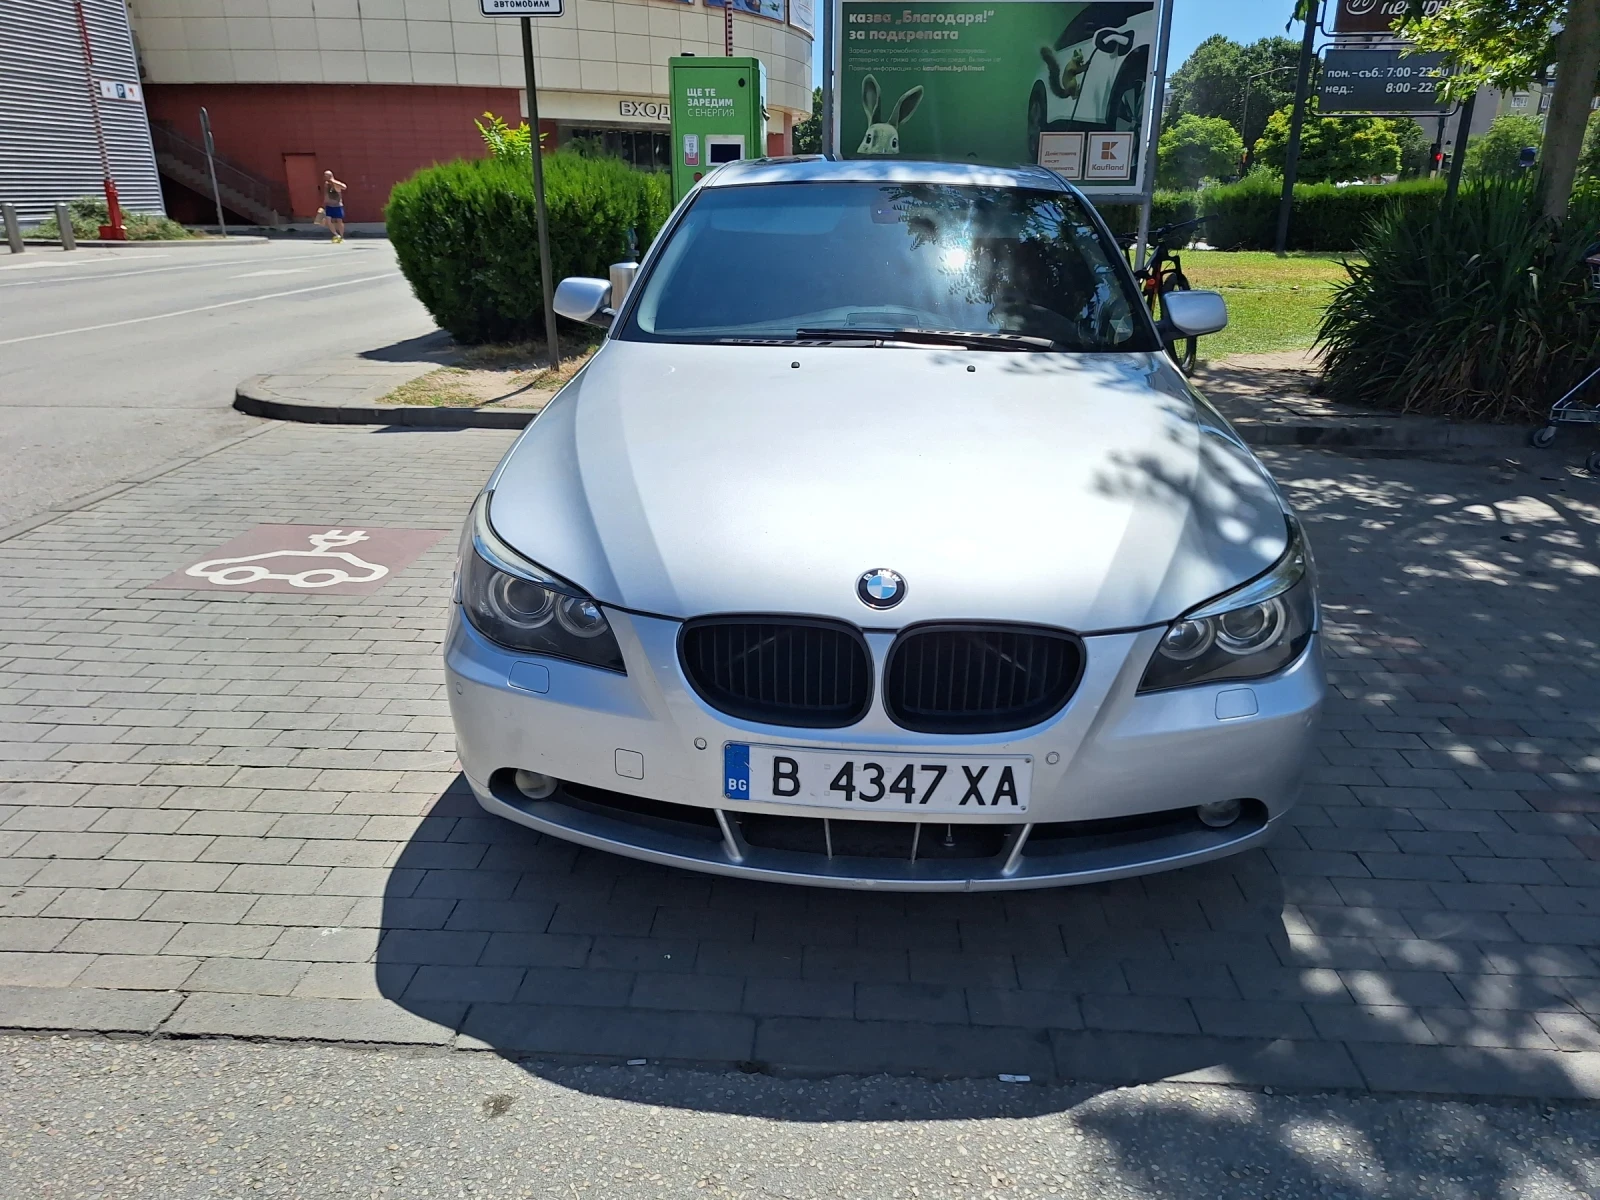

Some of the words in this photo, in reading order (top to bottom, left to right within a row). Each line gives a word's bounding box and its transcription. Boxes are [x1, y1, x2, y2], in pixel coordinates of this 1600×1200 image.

[849, 13, 892, 23] казва
[849, 30, 865, 40] за
[869, 30, 959, 43] подкрепата
[922, 64, 985, 72] kaufland.bg/klimat
[686, 88, 703, 97] ЩЕ
[704, 88, 716, 97] ТЕ
[1325, 85, 1354, 96] нед.:
[687, 98, 734, 108] ЗАРЕДИМ
[620, 101, 670, 120] ВХОД
[687, 108, 694, 117] С
[695, 108, 735, 117] ЕНЕРГИЯ
[1091, 163, 1125, 171] Kaufland
[863, 569, 902, 582] BMW
[728, 779, 747, 791] BG
[772, 756, 801, 797] B
[829, 761, 948, 805] 4347
[958, 765, 1019, 806] XA
